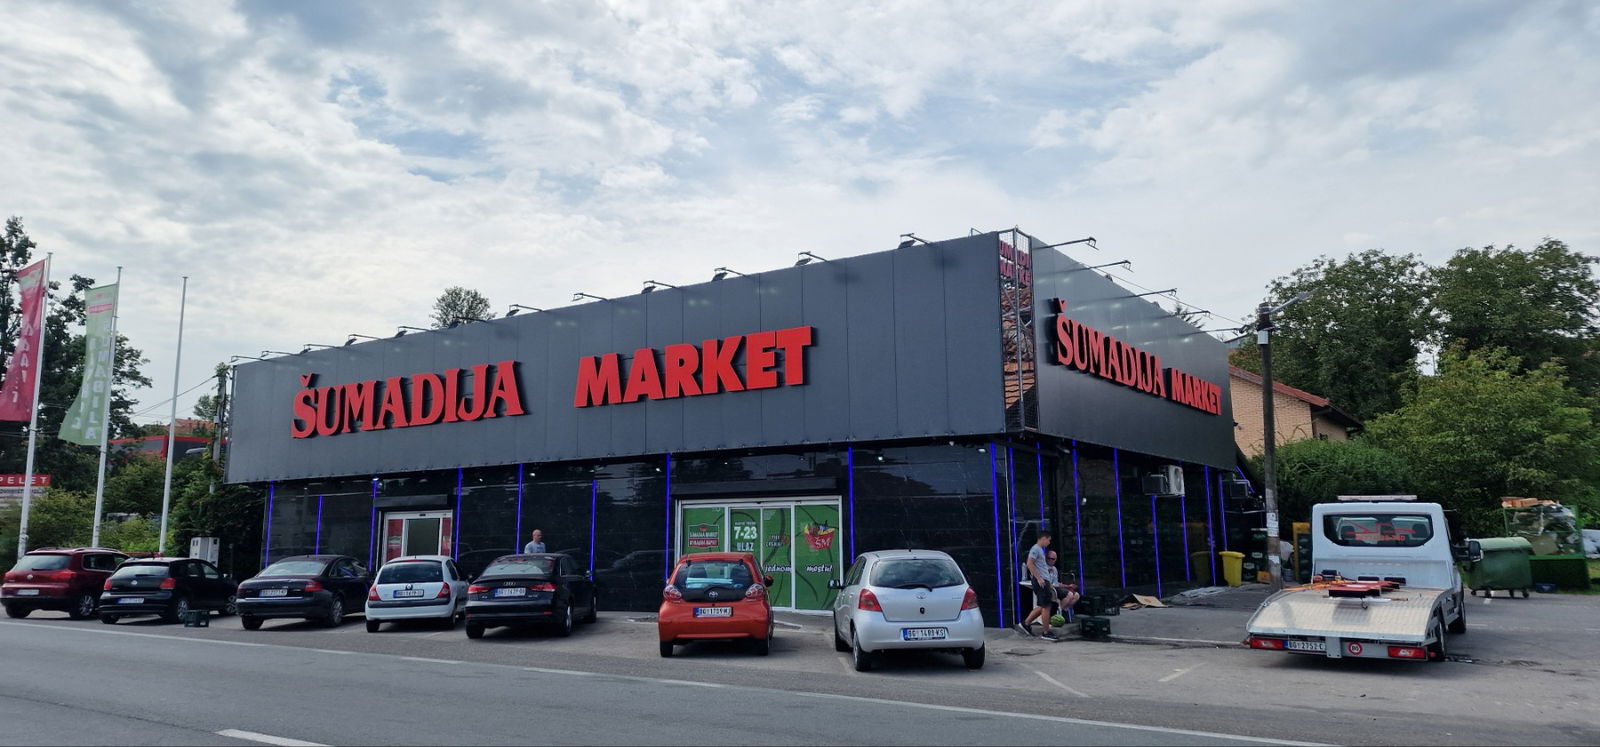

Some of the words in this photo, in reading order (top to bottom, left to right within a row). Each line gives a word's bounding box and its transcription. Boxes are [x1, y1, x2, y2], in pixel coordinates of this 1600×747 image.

[291, 360, 525, 439] ŠUMADIJA
[573, 325, 812, 408] MARKET
[1056, 299, 1167, 398] ŠUMADIJA
[1171, 367, 1222, 416] MARKET
[733, 526, 758, 540] 7-23
[736, 542, 754, 551] ULAZ
